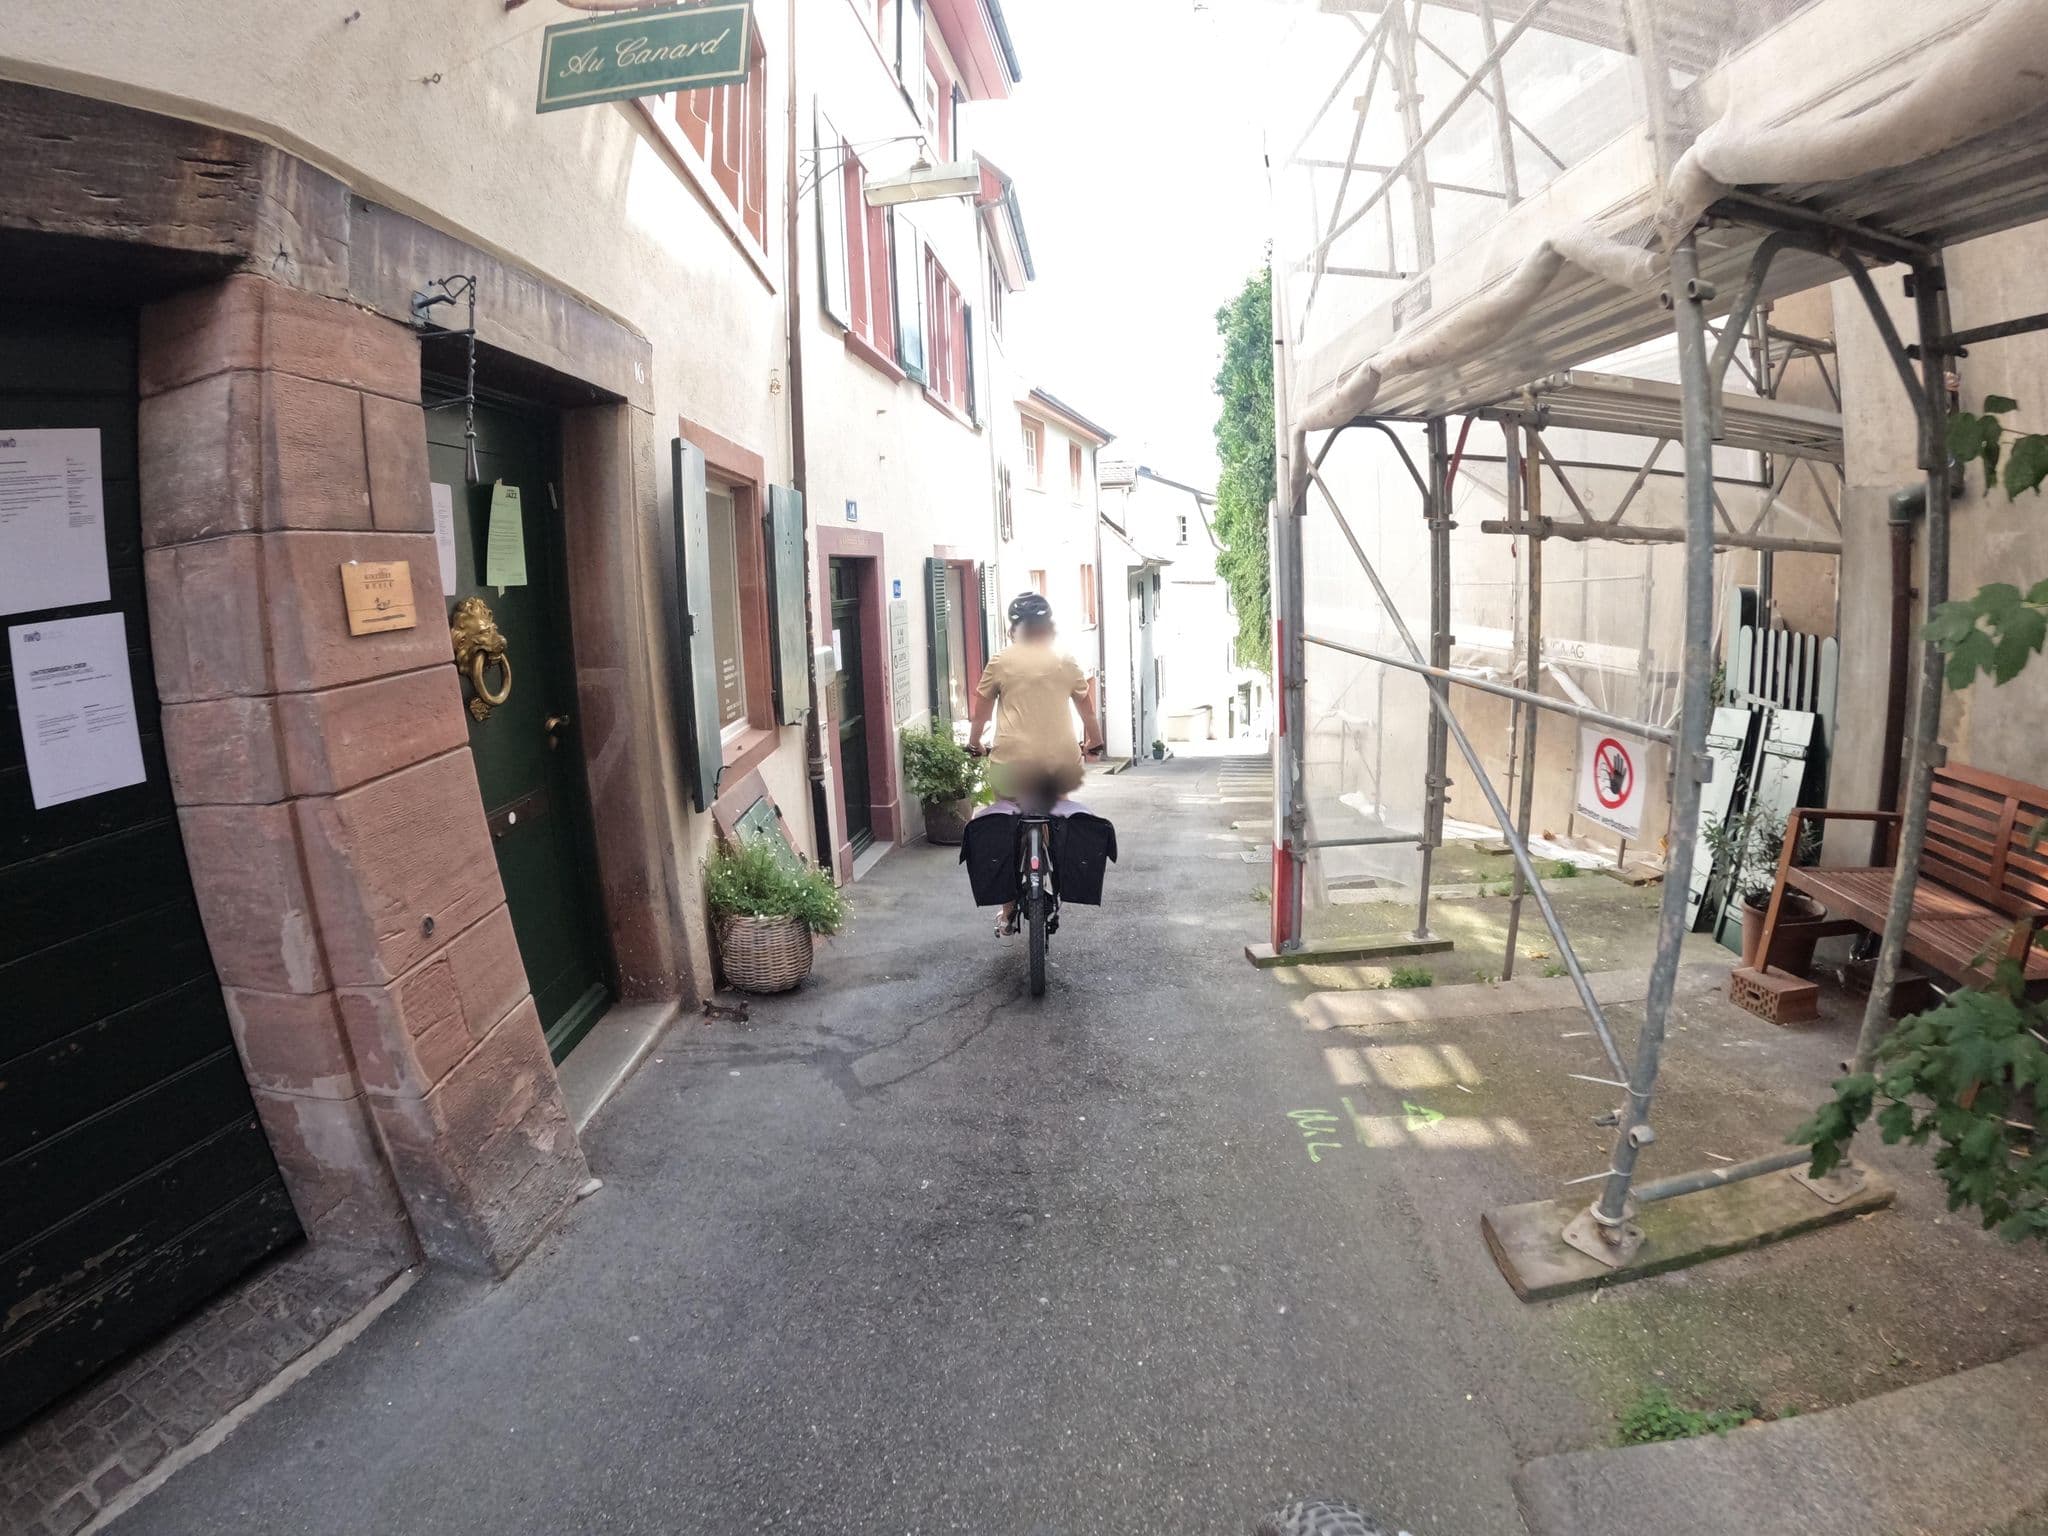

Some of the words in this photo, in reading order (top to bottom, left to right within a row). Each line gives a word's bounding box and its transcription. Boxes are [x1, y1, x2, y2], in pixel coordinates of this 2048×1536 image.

[560, 46, 605, 78] Au
[616, 28, 730, 68] Canard
[634, 361, 645, 385] 16
